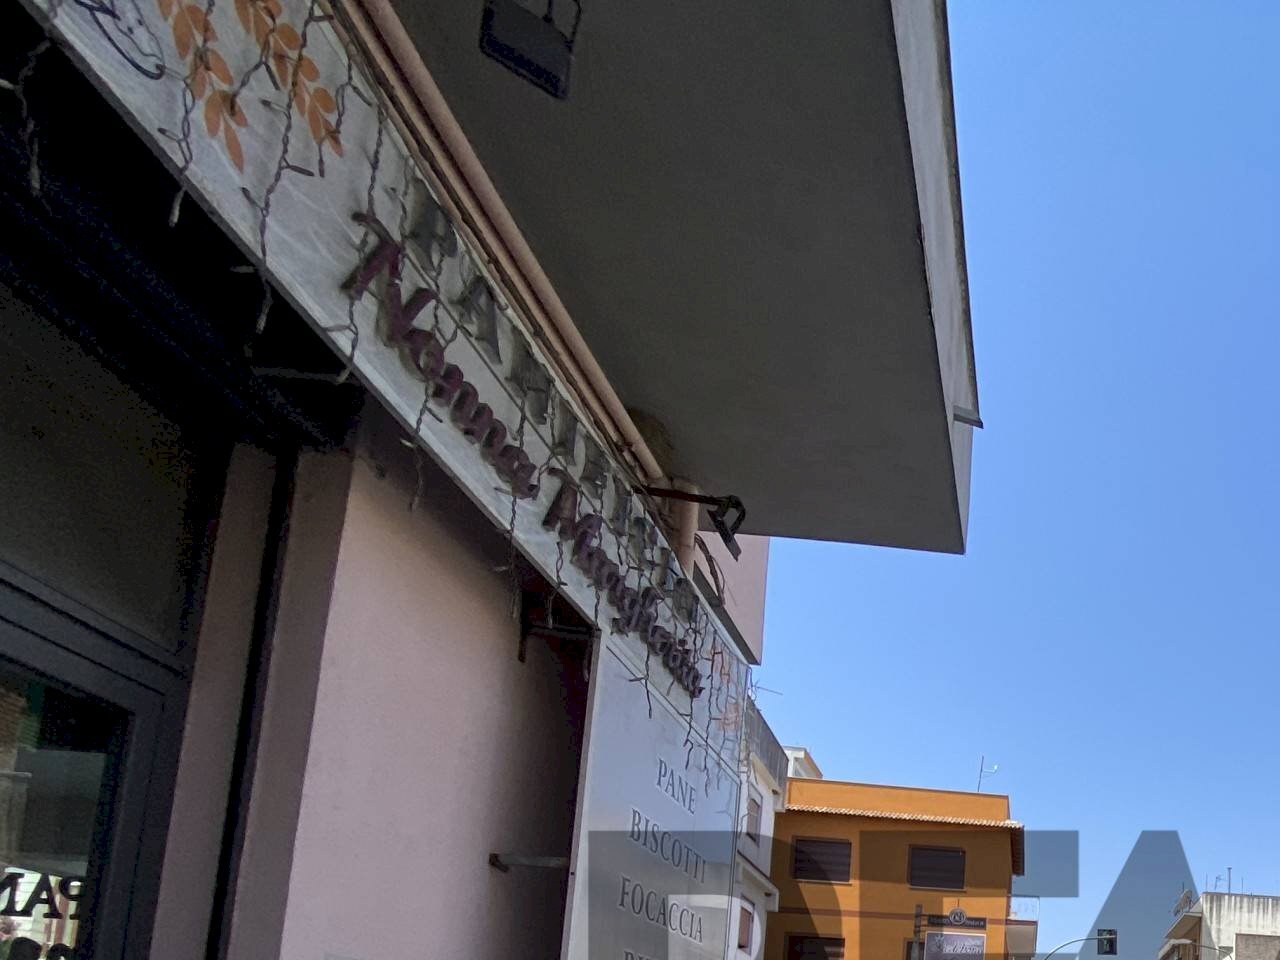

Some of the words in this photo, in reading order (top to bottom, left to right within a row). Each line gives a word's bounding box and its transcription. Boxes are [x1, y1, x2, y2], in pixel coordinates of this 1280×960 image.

[340, 211, 538, 499] Nonna
[656, 757, 697, 815] PANE
[629, 807, 706, 884] BISCOTTI
[618, 875, 703, 943] FOCACCIA
